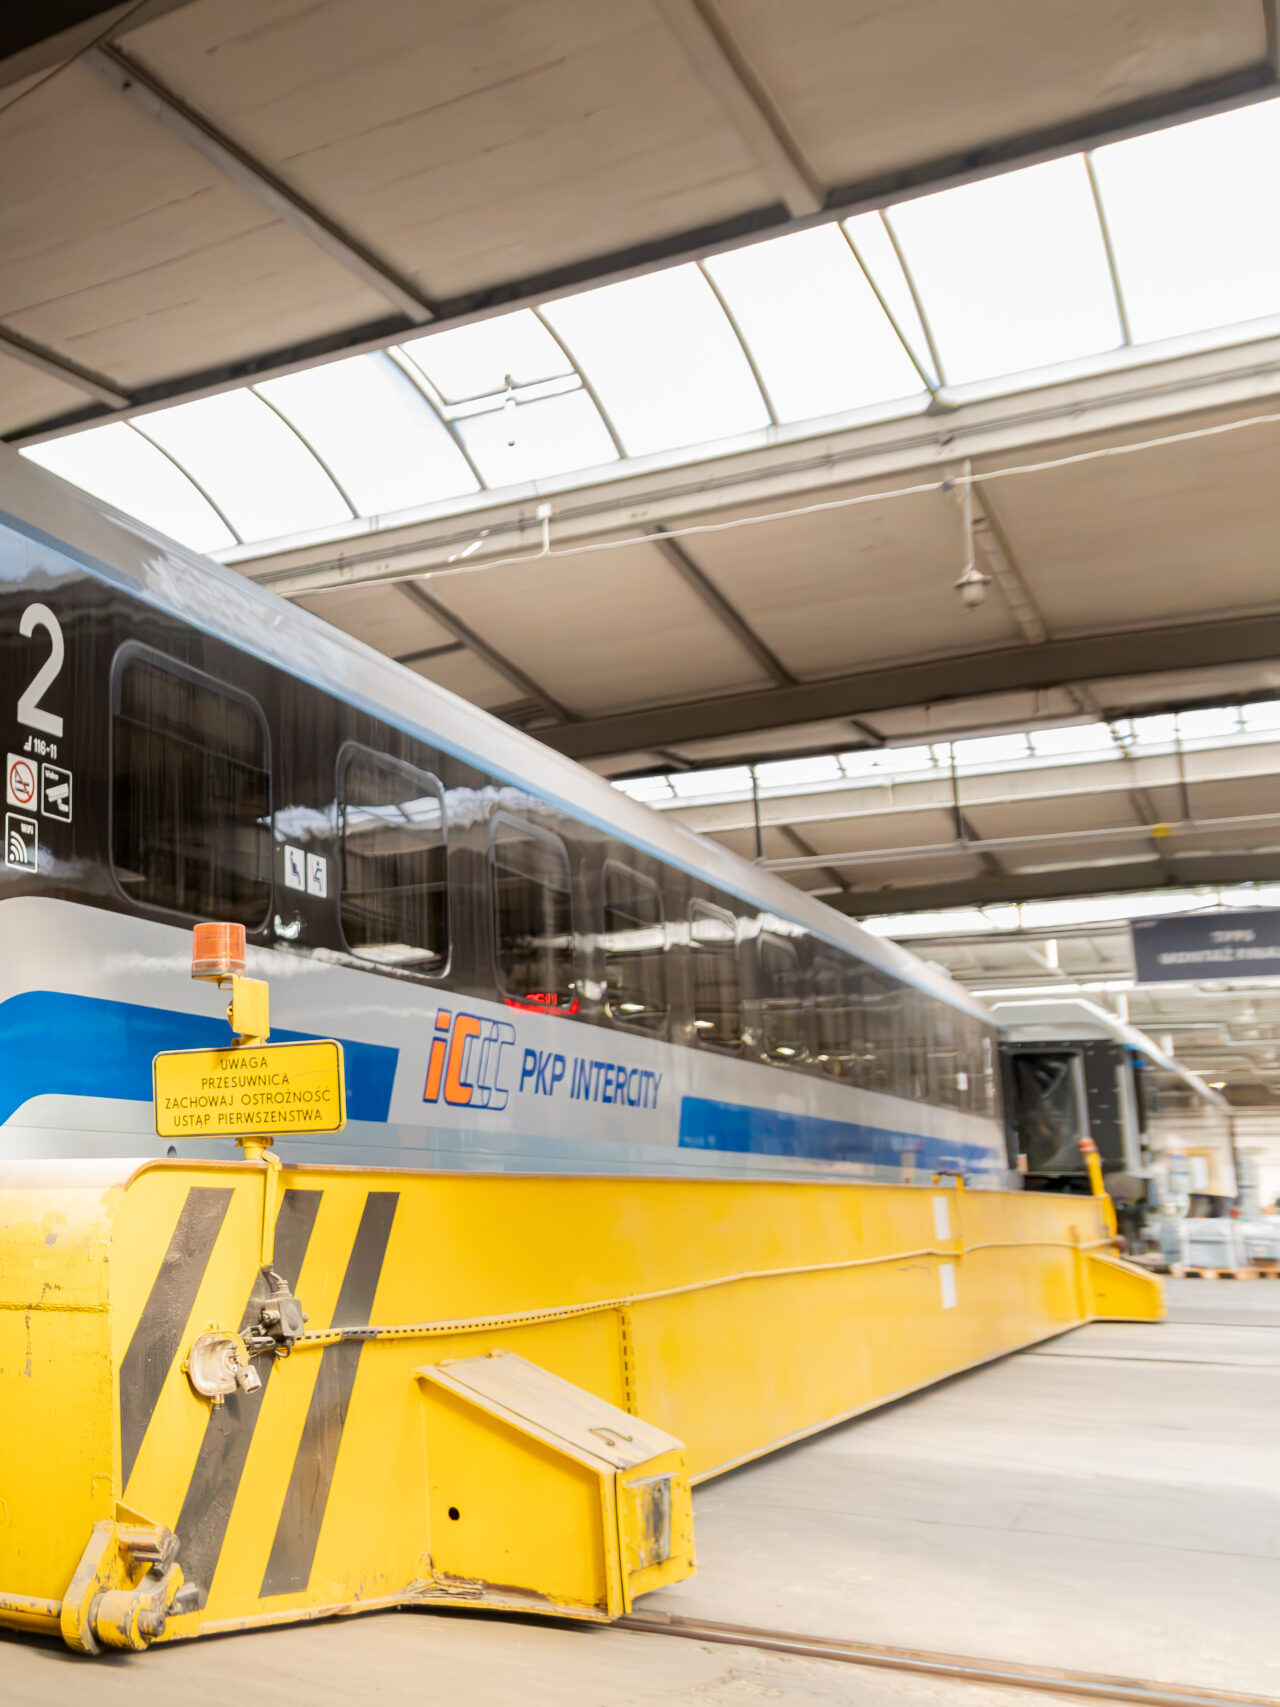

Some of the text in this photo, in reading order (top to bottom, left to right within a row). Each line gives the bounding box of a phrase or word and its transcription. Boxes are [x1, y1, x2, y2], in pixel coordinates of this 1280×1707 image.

[17, 602, 64, 738] 2
[220, 1056, 268, 1070] UWAGA
[201, 1073, 290, 1089] PRZESUWNICA
[519, 1048, 662, 1110] PKP INTERCITY
[165, 1085, 331, 1110] ZACHOWAJ OSTROŻNOŚĆ
[173, 1107, 323, 1128] USTĄP PIERWSZEŃSTWA
